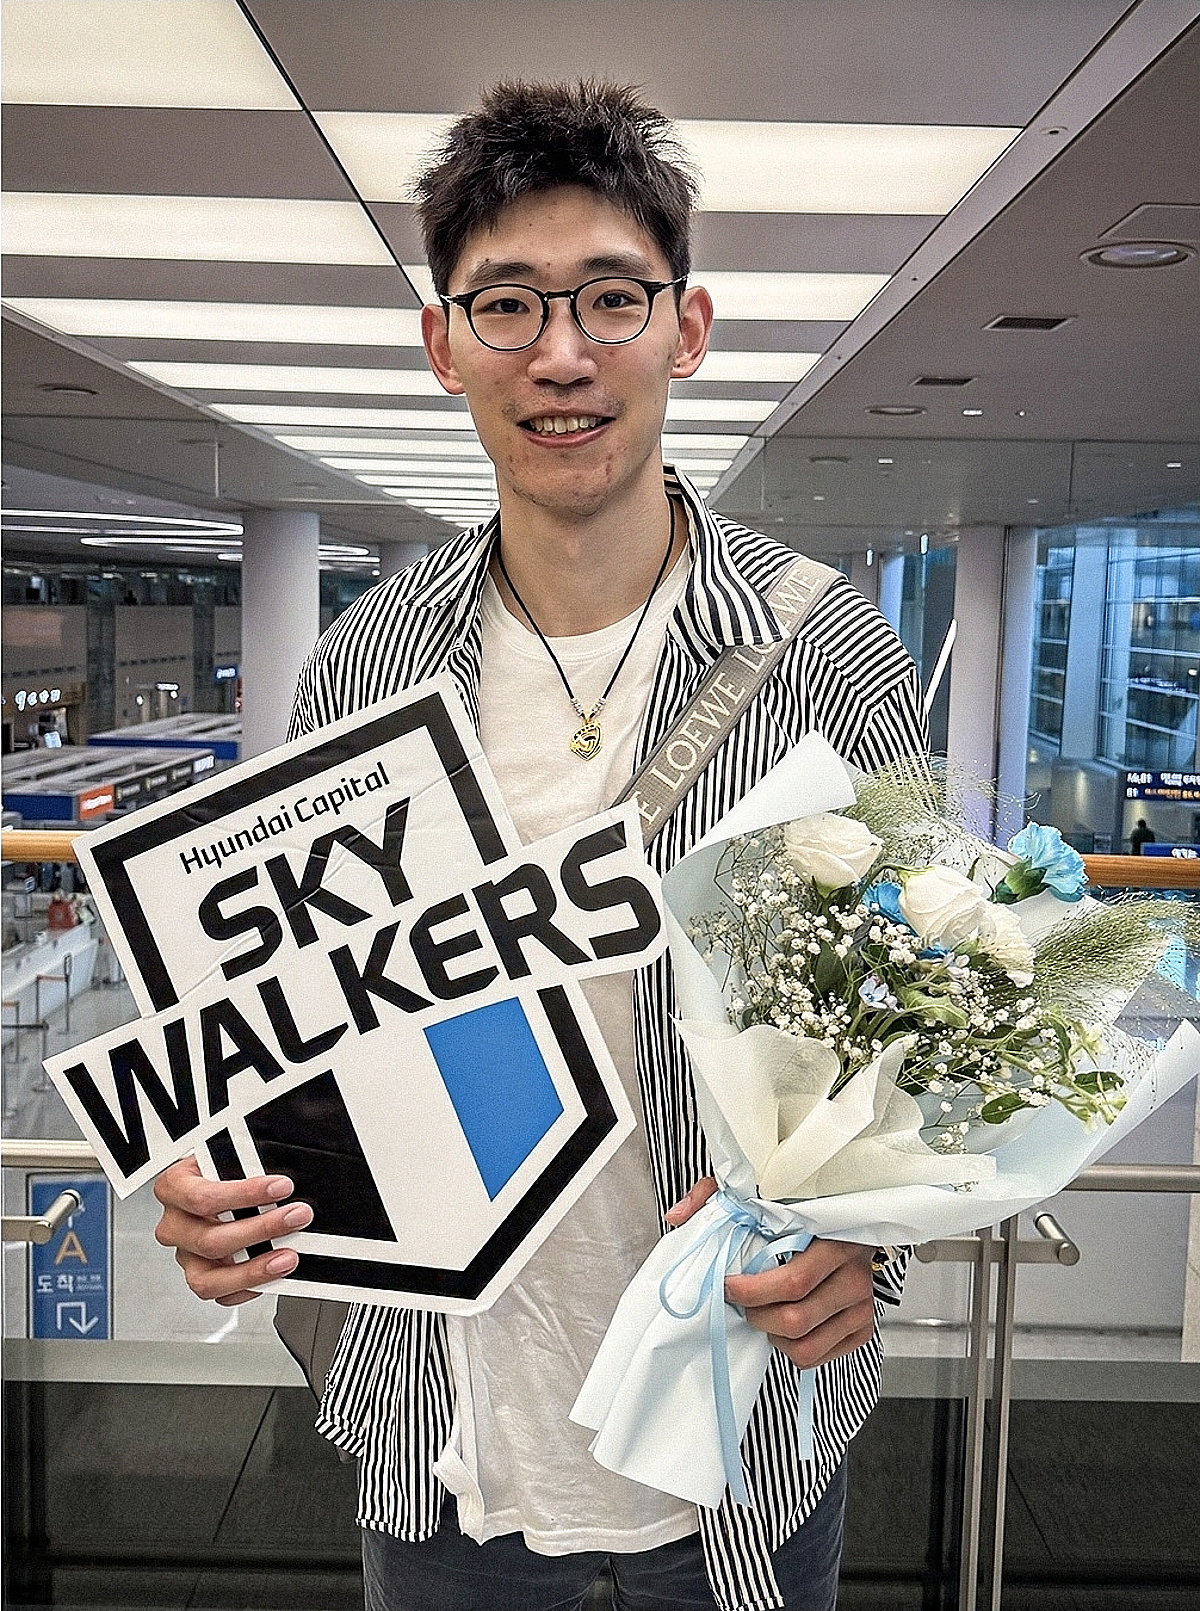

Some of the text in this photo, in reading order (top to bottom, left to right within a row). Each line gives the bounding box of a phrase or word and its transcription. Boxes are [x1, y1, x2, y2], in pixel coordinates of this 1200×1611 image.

[649, 672, 747, 791] LOEWE
[179, 761, 390, 875] Hyundai Capital
[198, 796, 411, 981] SKY
[63, 820, 662, 1179] WALKERS
[55, 1231, 88, 1265] A
